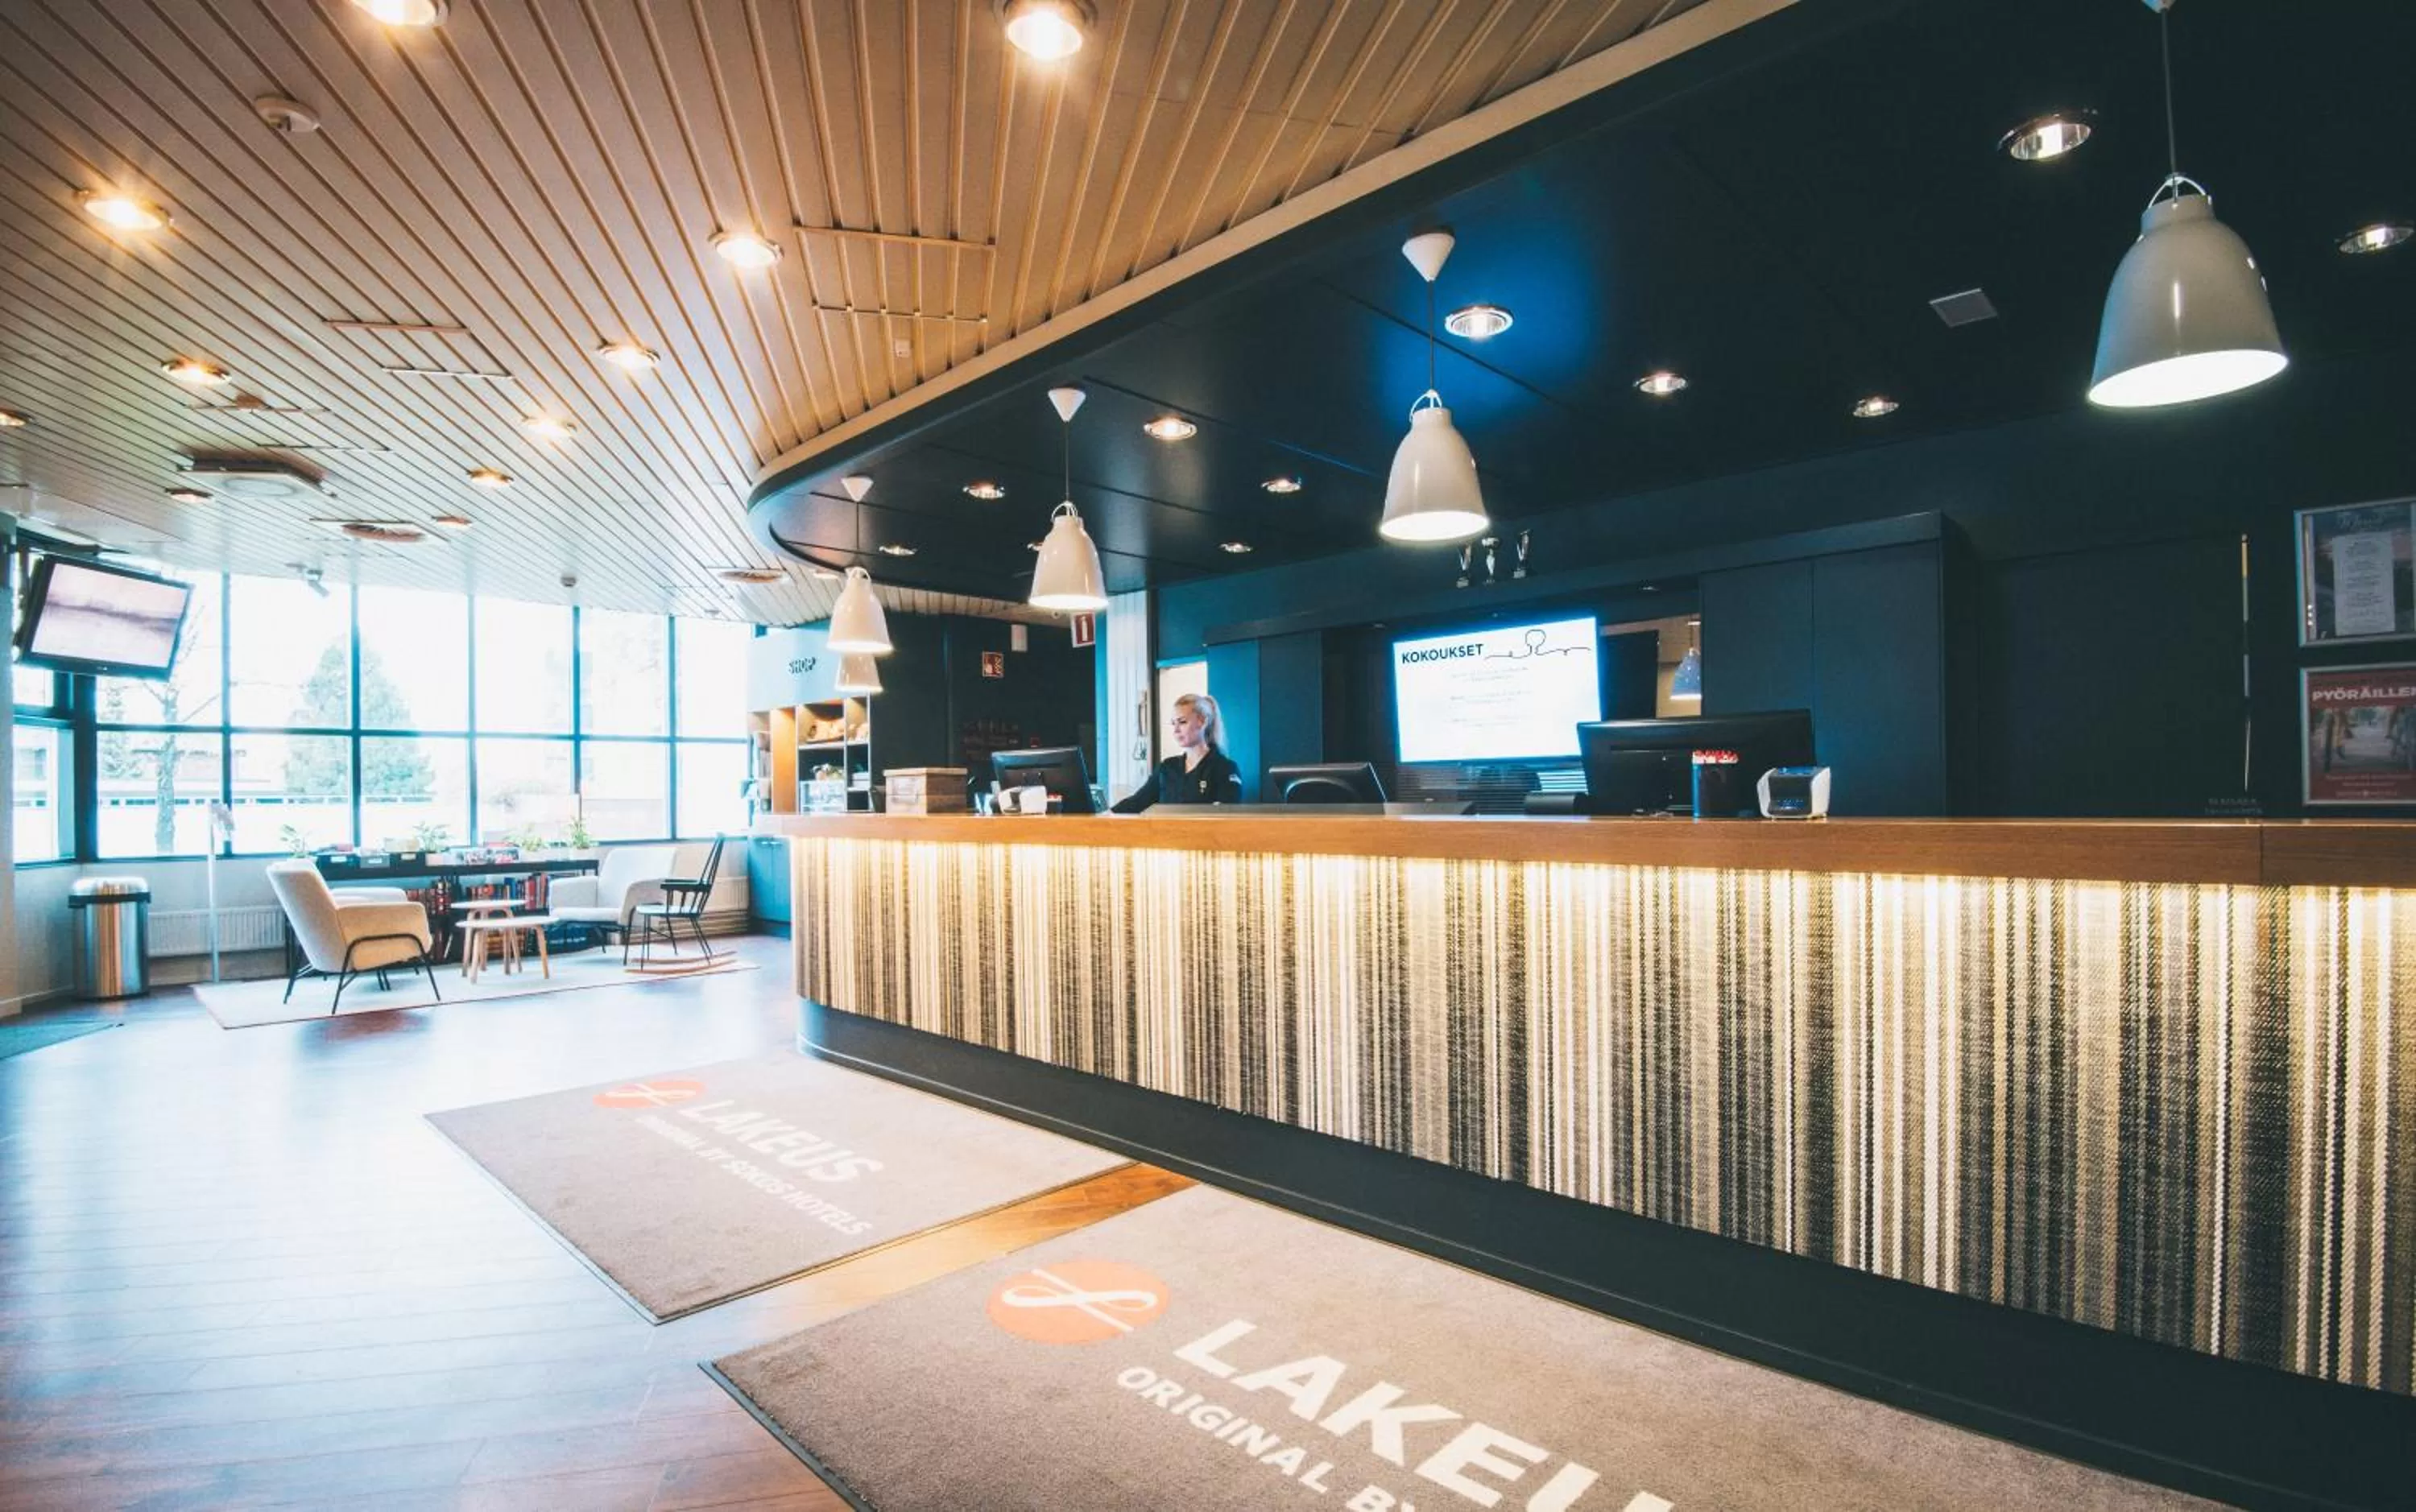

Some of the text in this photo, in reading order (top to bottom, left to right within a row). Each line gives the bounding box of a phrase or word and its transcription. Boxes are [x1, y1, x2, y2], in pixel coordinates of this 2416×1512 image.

[789, 657, 816, 673] SHOP
[1402, 644, 1484, 663] KOKOUKSET
[676, 1100, 883, 1182] LAKEUS
[1117, 1367, 1415, 1512] ORIGINAL B
